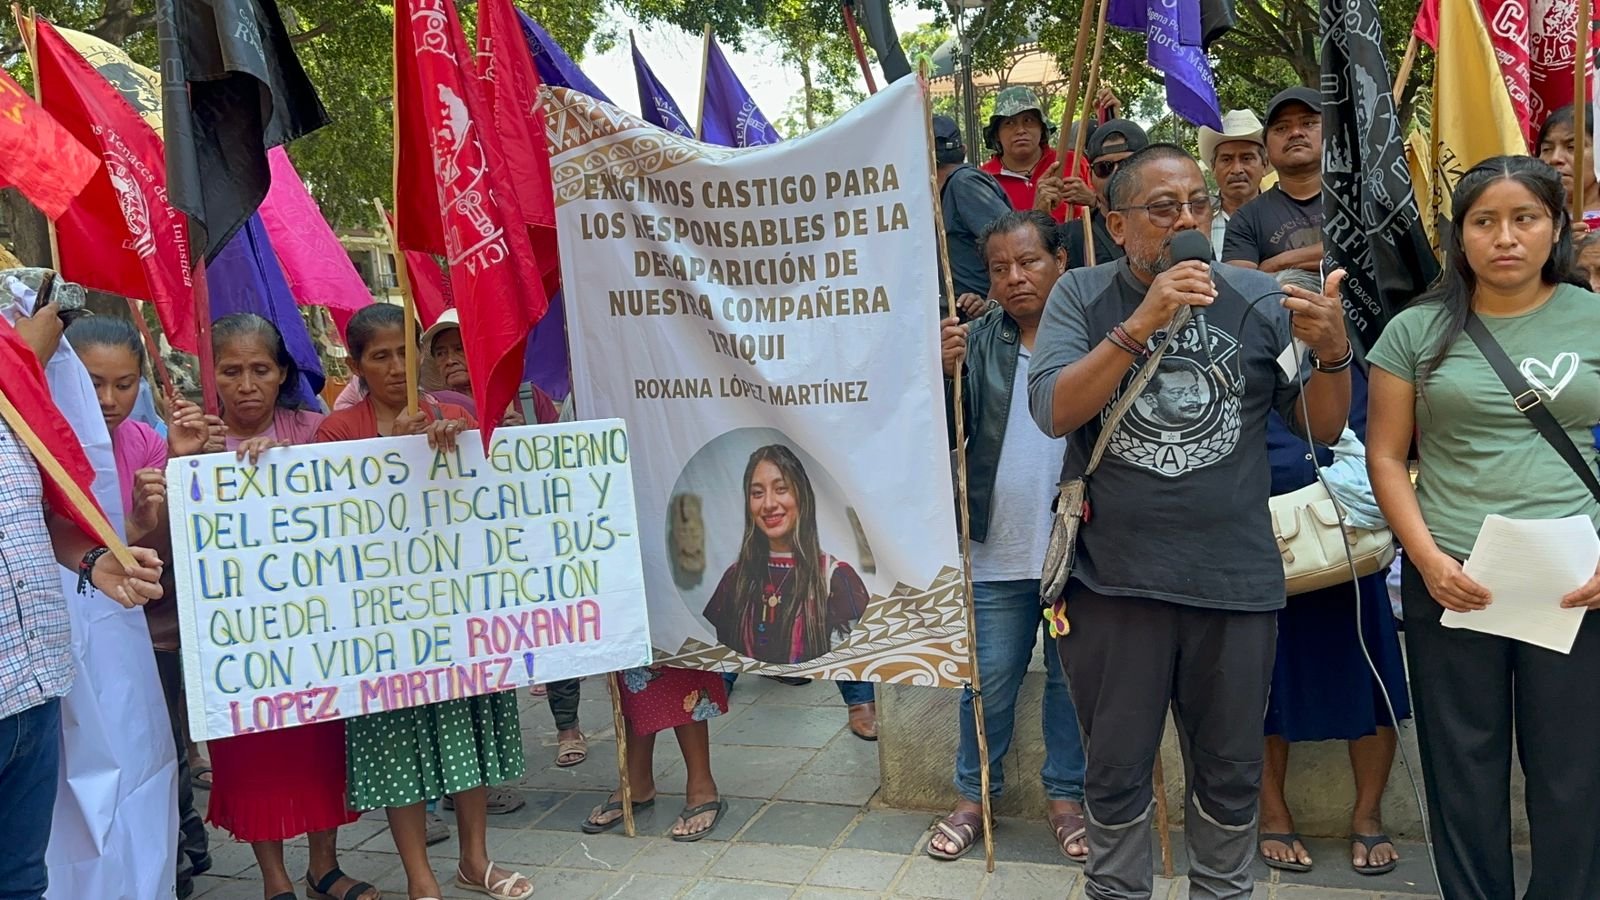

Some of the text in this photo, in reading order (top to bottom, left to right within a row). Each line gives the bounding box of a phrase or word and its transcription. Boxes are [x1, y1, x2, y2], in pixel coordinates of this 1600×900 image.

[1150, 25, 1185, 57] Flores
[107, 129, 156, 183] Tenaces
[153, 185, 169, 203] de
[166, 206, 176, 219] la
[172, 223, 193, 288] Injusticia
[583, 164, 899, 208] EXIGIMOS CASTIGO PARA
[580, 202, 909, 248] LOS RESPONSABLES DE LA
[634, 249, 858, 286] DESAPARICIÓN DE
[608, 285, 890, 323] NUESTRA COMPAÑERA
[1348, 278, 1382, 316] Oaxaca
[708, 328, 785, 365] TRIQUI
[635, 373, 868, 406] ROXANA LÓPEZ MARTÍNEZ
[430, 445, 477, 480] AL
[491, 428, 628, 472] GOBIERNO
[191, 472, 611, 552] DEL ESTADO, FISCALÍA Y
[198, 558, 242, 599] LA
[258, 530, 461, 592] COMISIÓN
[485, 526, 529, 566] DE
[210, 556, 600, 646] QUEDA. PRESENTACIÓN
[215, 599, 601, 694] CON VIDA DE ROXANA
